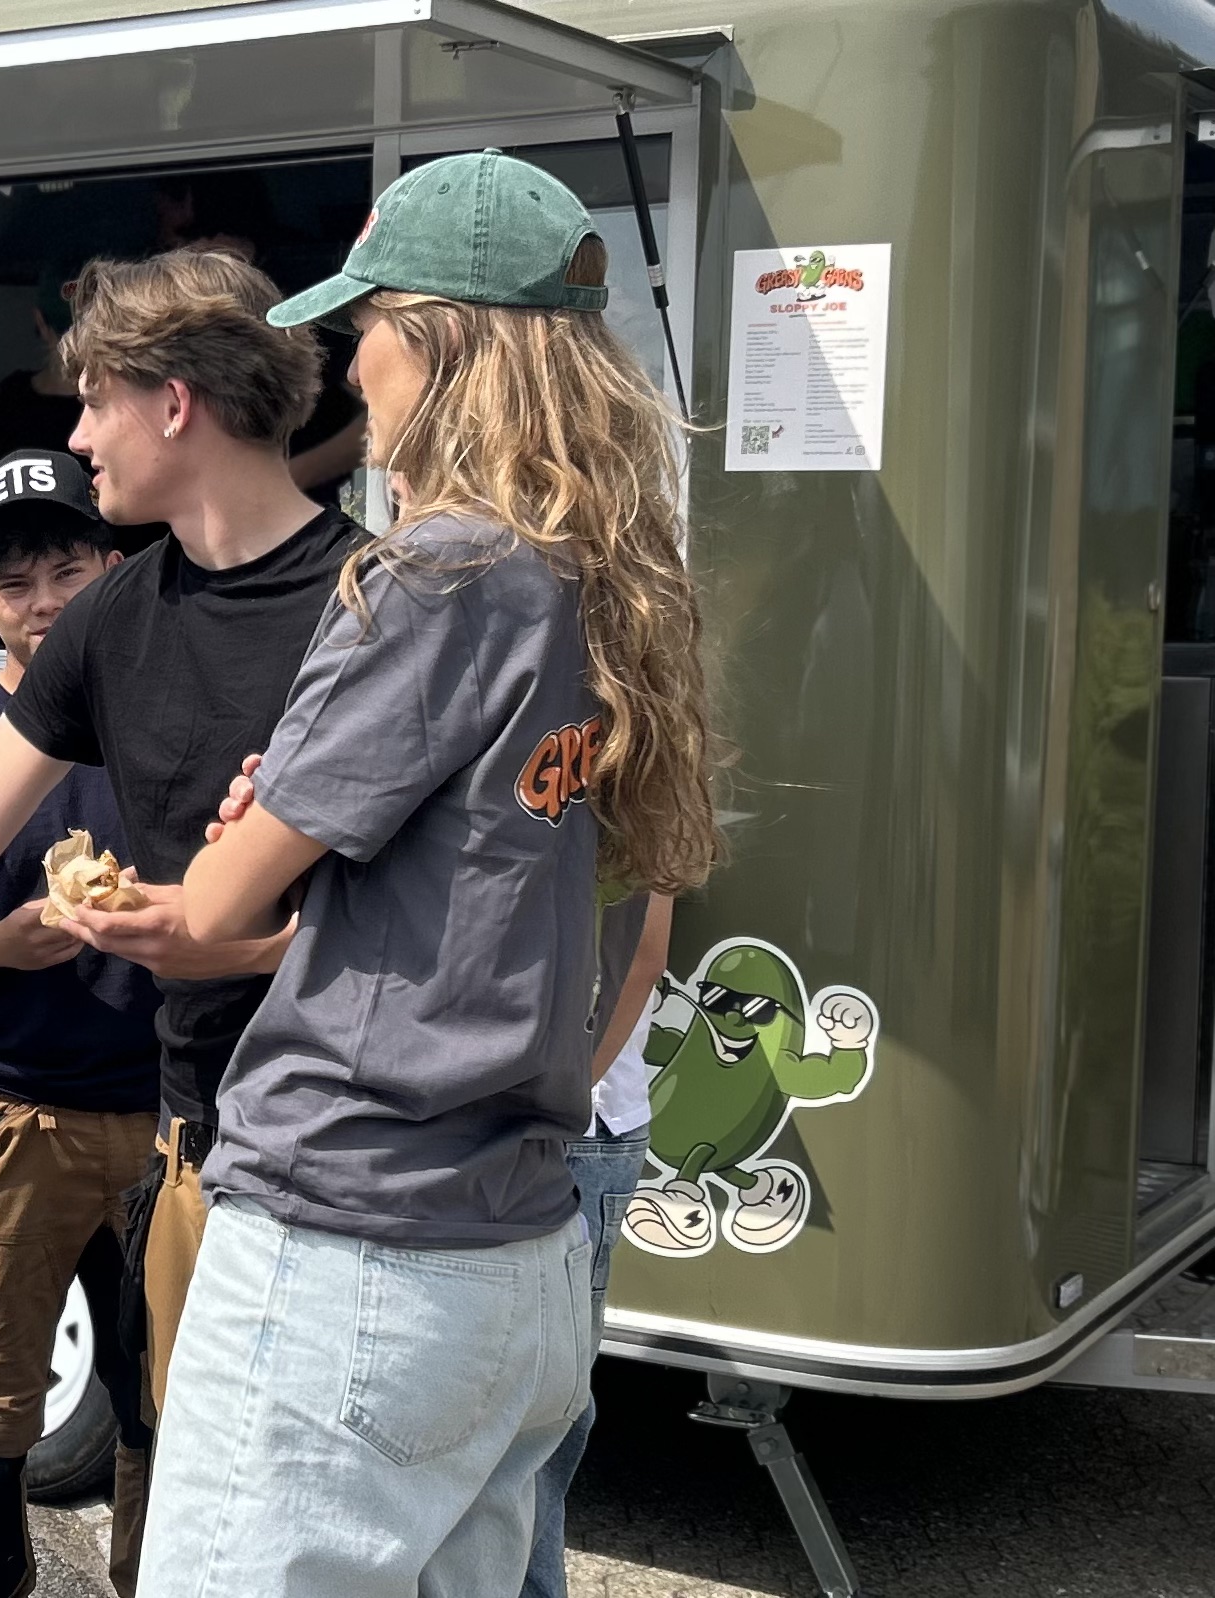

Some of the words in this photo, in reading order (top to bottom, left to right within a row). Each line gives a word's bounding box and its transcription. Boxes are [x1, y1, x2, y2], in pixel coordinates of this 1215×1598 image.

[756, 269, 802, 295] GREASY
[770, 304, 818, 314] SLOPPY
[823, 303, 846, 312] JOE
